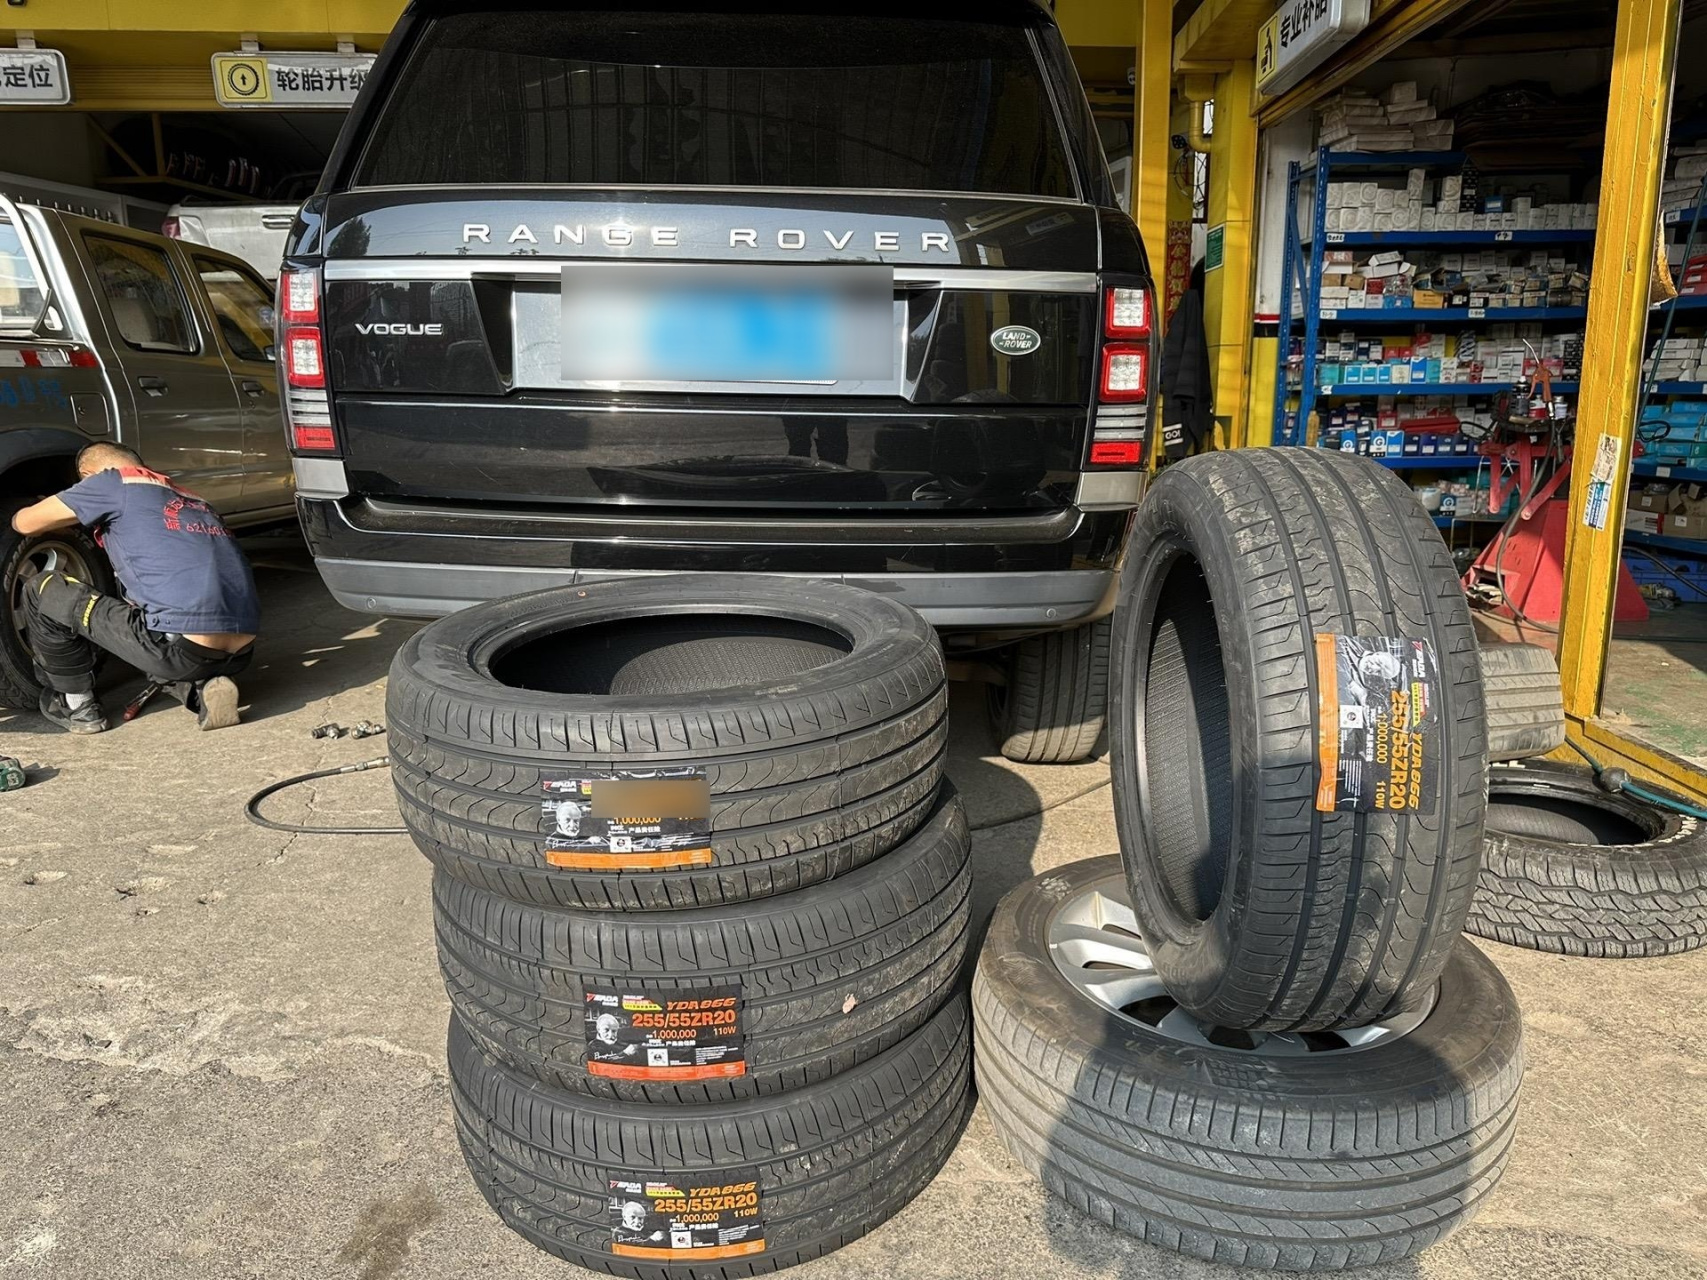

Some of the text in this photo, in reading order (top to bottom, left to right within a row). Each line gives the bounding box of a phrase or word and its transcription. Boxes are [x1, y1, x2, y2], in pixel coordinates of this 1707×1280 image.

[0, 64, 53, 88] 定位
[463, 224, 949, 252] RANGE ROVER
[354, 323, 442, 335] VOGUE
[1002, 331, 1026, 340] LAND
[1003, 340, 1032, 348] ROVER
[1377, 712, 1389, 764] 1,000,000
[1389, 690, 1410, 809] 255/55ZR20
[1375, 780, 1386, 809] 110W
[632, 1009, 736, 1028] 255/55ZR20
[652, 1029, 697, 1039] 1,000,000
[713, 1026, 737, 1036] 110W
[654, 1192, 757, 1213] 255/55ZR20
[676, 1212, 719, 1224] 1,000,000
[733, 1207, 758, 1219] 110W
